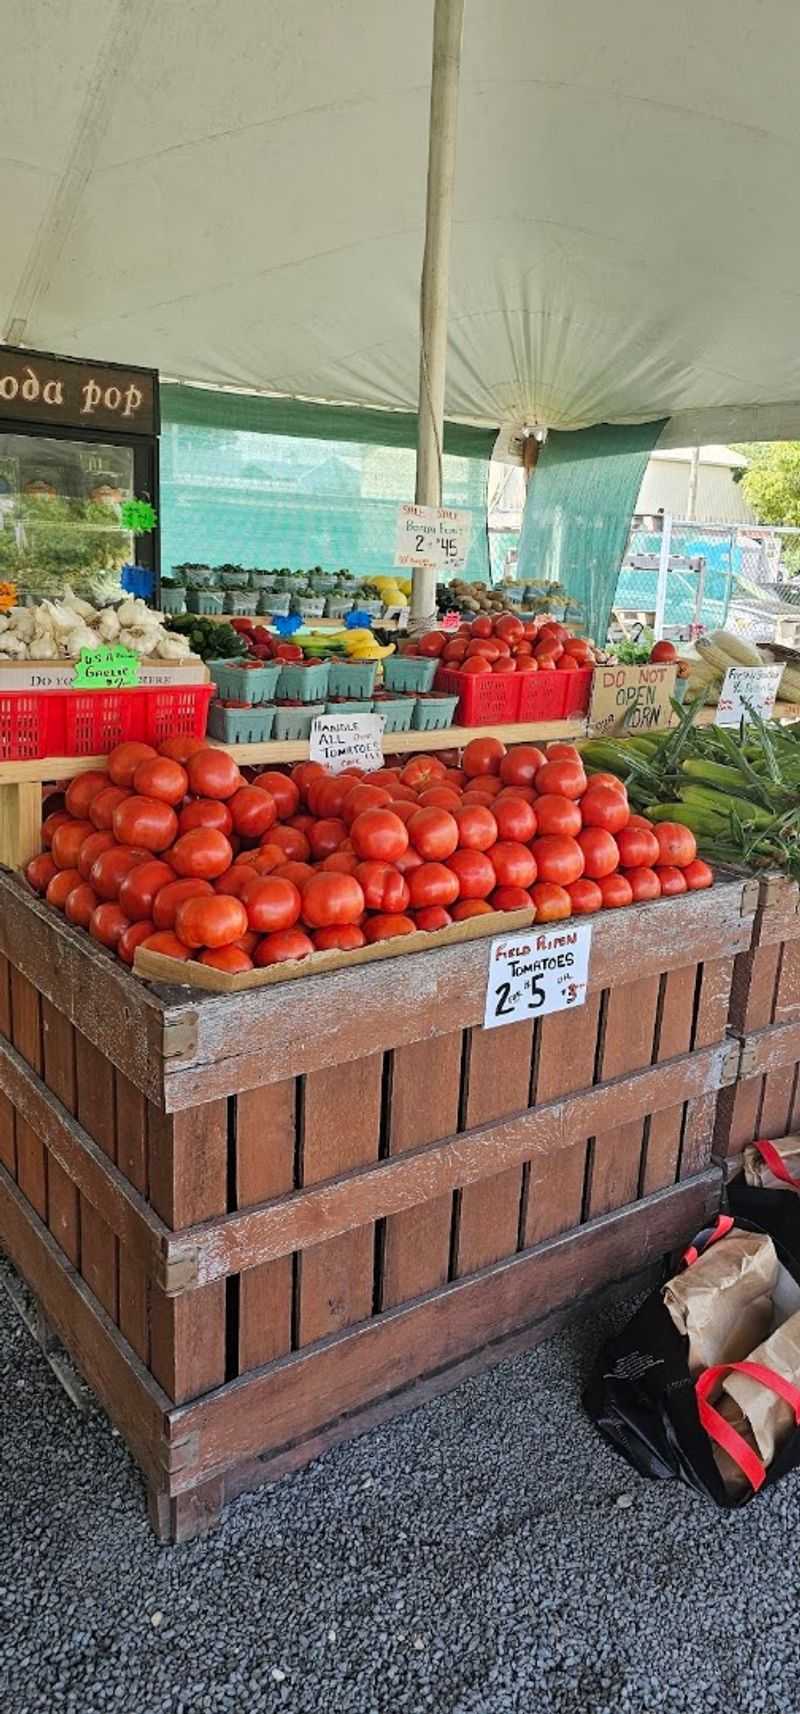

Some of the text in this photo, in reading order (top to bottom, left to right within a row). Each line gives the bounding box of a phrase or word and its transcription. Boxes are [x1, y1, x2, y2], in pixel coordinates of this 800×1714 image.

[80, 380, 142, 417] pop
[415, 535, 425, 552] 2
[603, 668, 668, 688] DO NOT
[616, 686, 657, 706] OPEN
[314, 720, 359, 733] HANDLE
[626, 705, 662, 728] ORN
[319, 733, 346, 745] ALL
[320, 741, 380, 759] TOMATOES
[495, 932, 577, 961] FIELD RIPEN
[507, 952, 575, 977] TOMATOES
[495, 982, 515, 1017] 2
